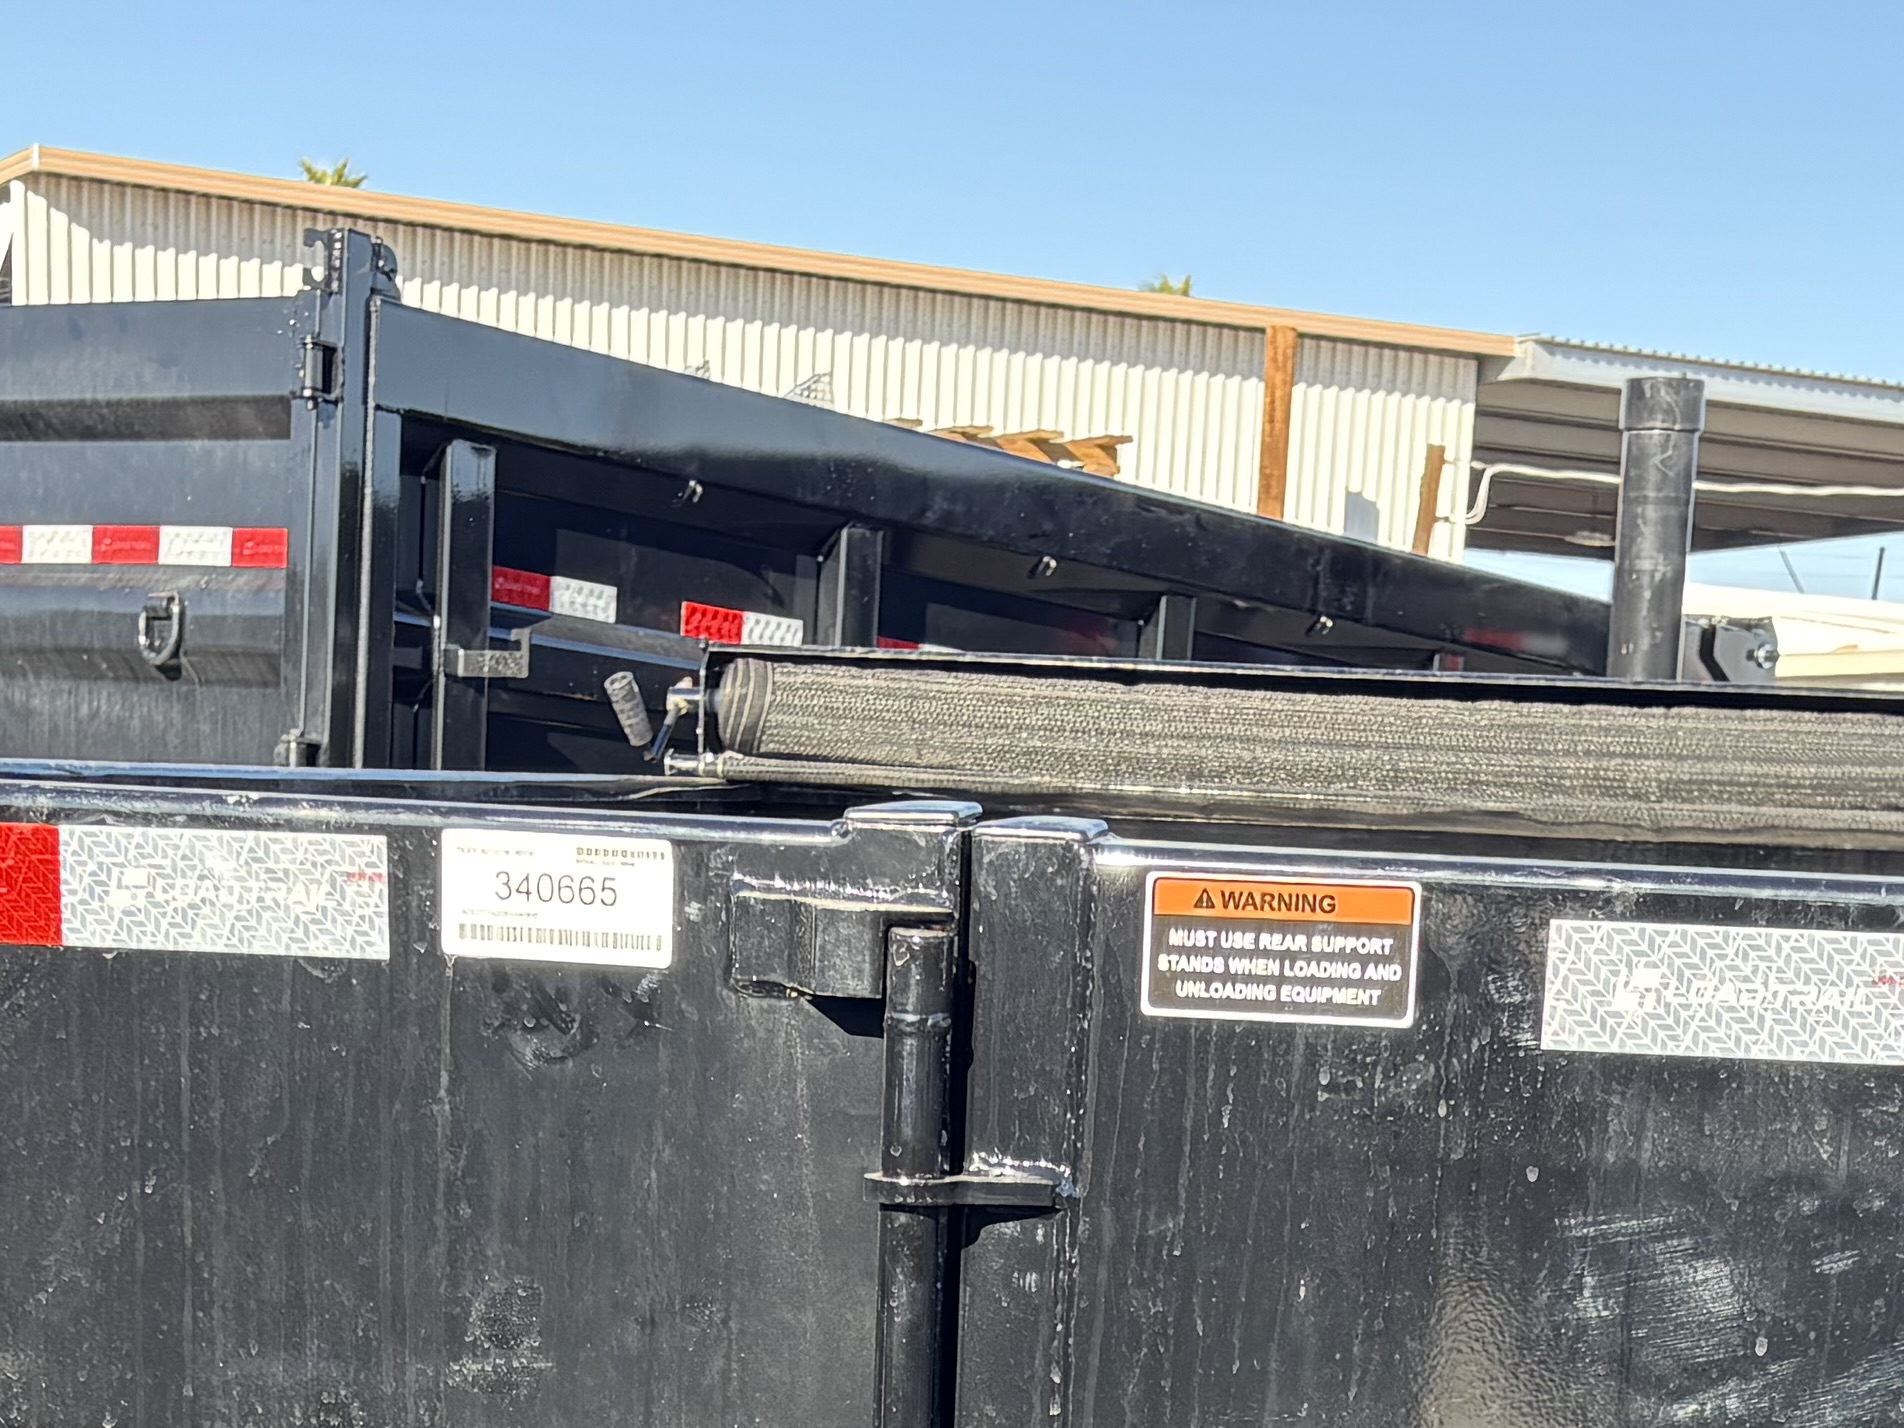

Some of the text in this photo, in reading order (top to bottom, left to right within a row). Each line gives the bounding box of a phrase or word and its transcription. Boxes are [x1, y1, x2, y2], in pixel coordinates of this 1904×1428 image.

[494, 870, 618, 907] 340665
[1219, 889, 1337, 915] WARNING
[1168, 927, 1394, 956] MUST USE REAR SUPPORT
[1157, 953, 1403, 982] STANDS WHEN LOADING AND
[1175, 979, 1382, 1007] UNLOADING EQUIPMENT
